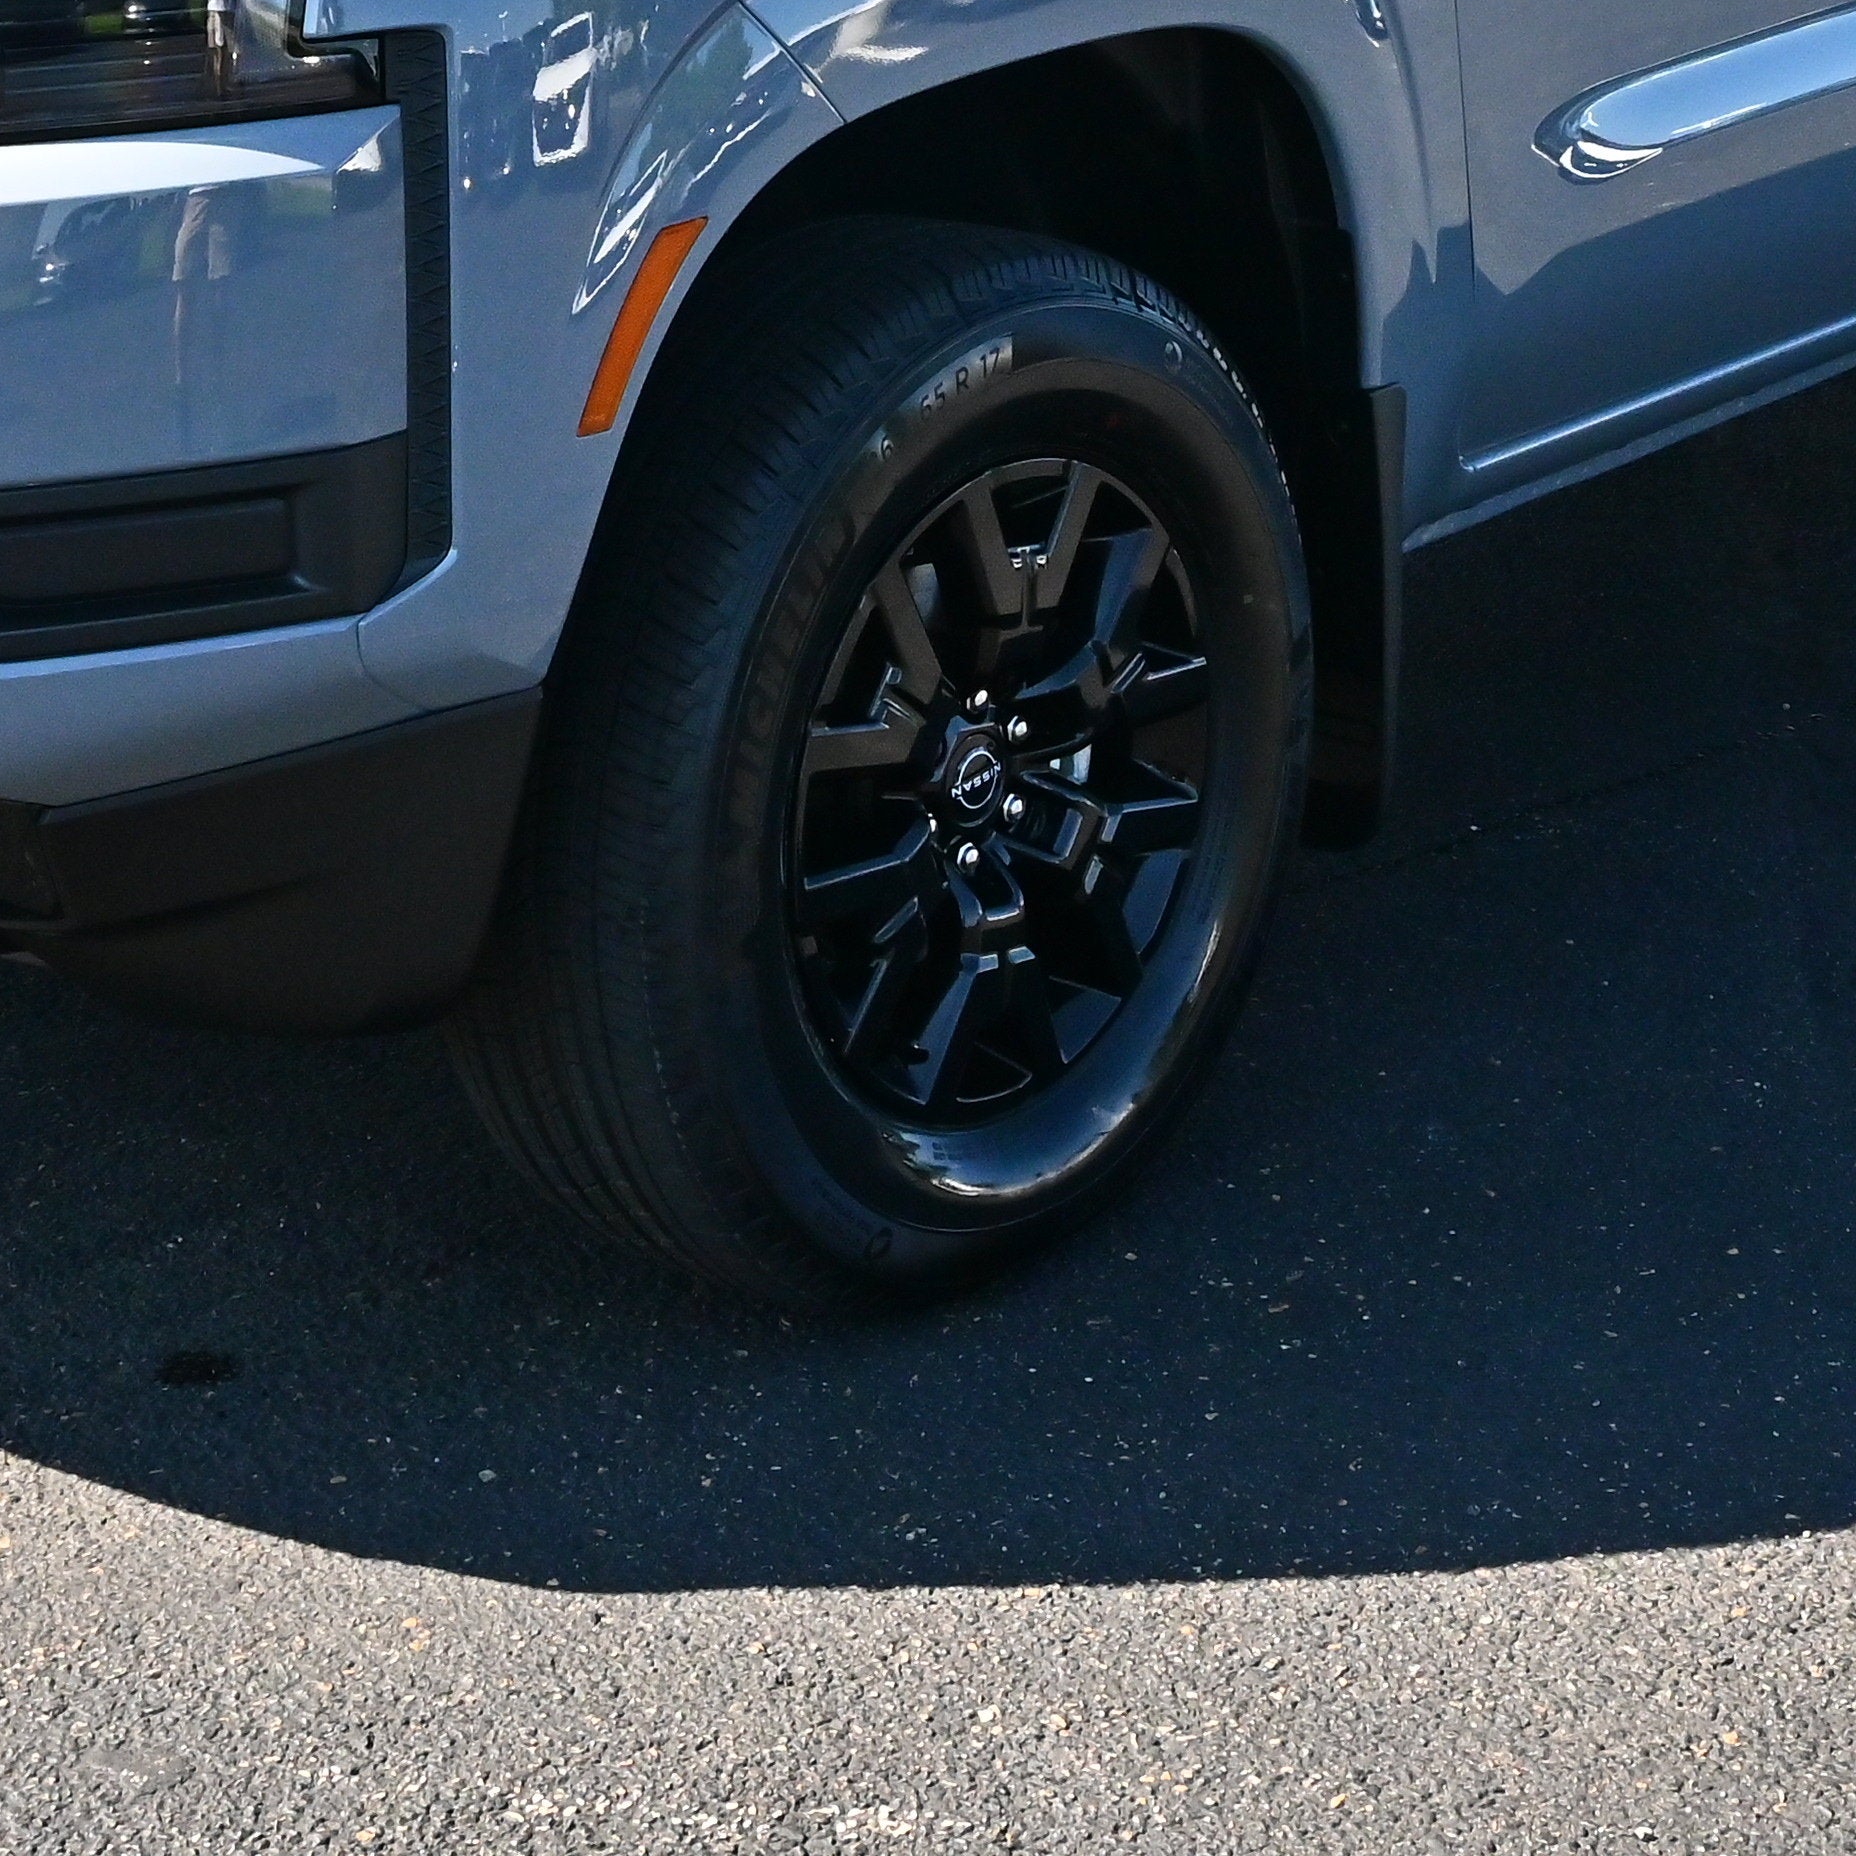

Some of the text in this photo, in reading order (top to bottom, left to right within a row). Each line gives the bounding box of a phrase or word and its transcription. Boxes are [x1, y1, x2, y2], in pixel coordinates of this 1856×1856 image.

[920, 347, 1001, 423] 65 R 17
[951, 762, 1001, 798] NISSAN
